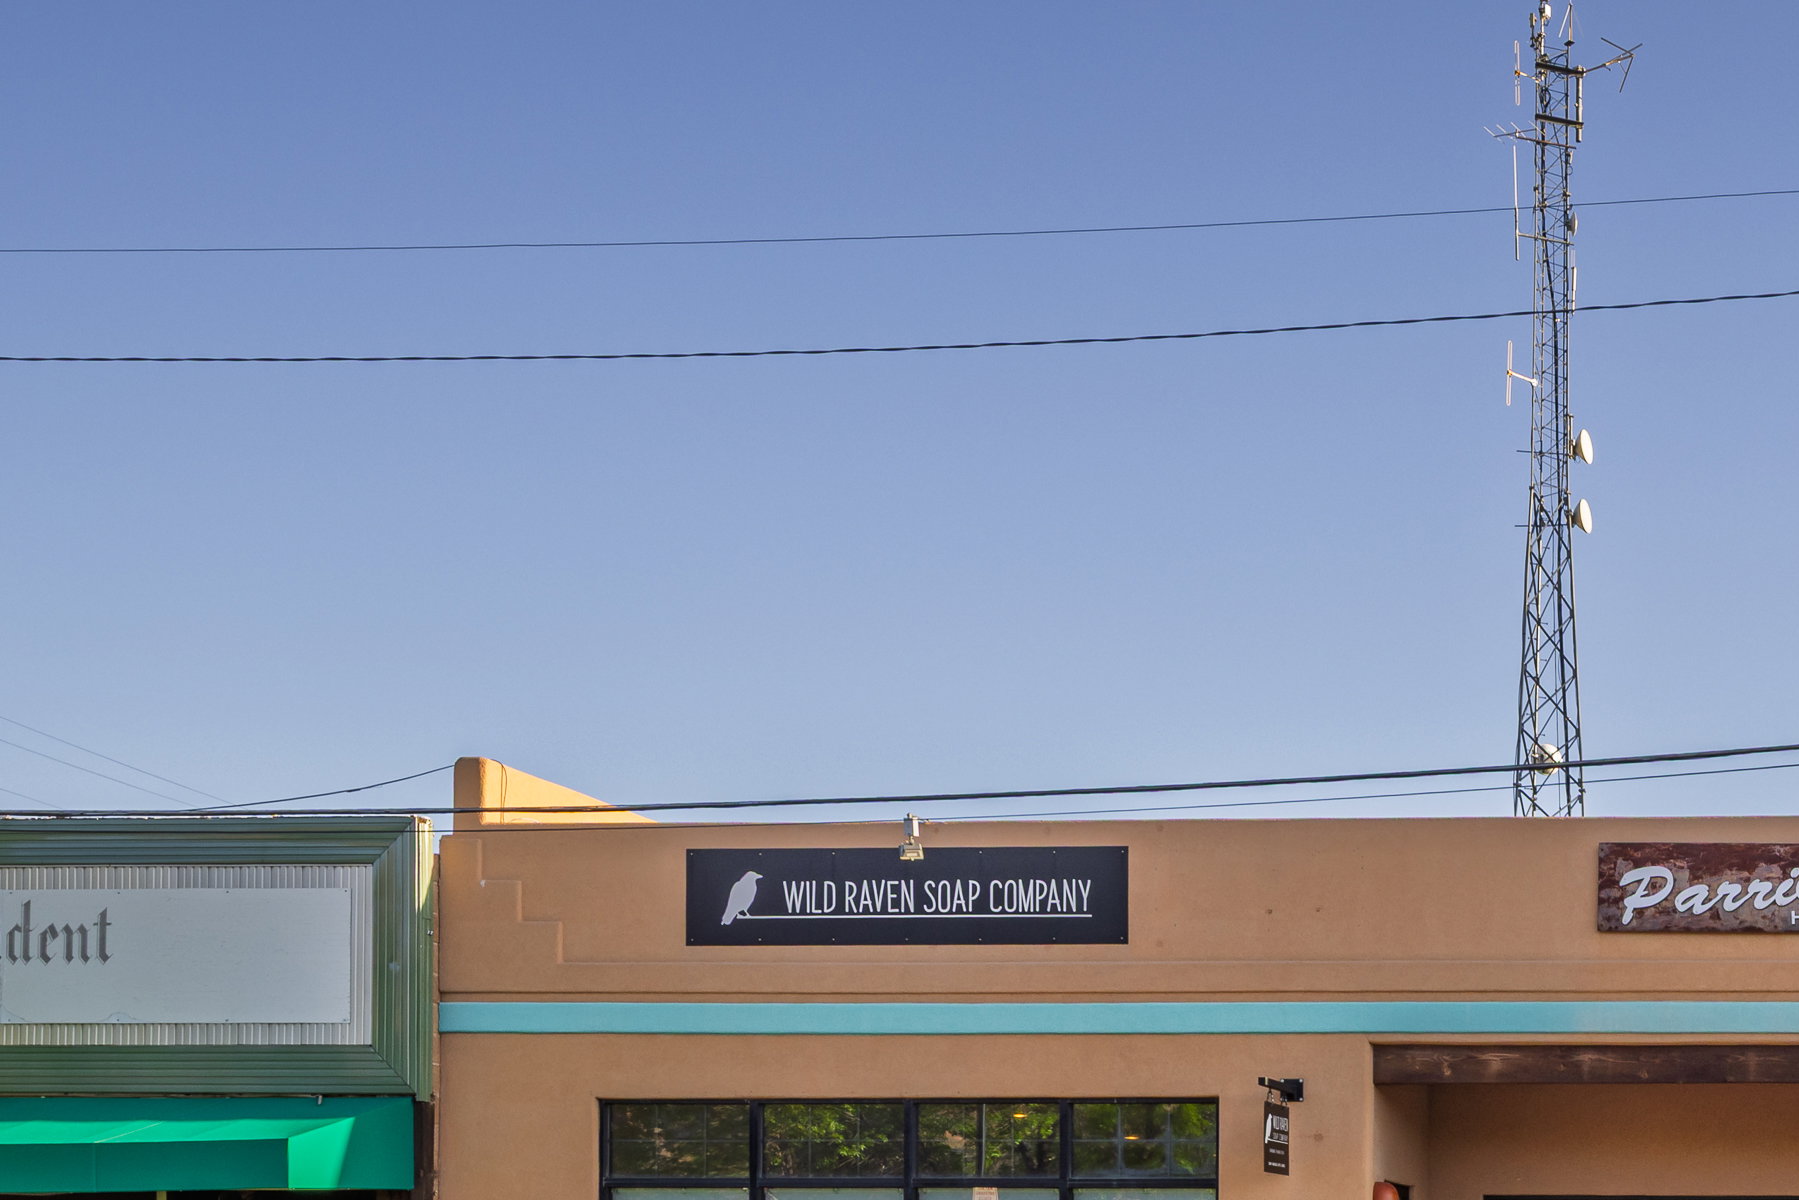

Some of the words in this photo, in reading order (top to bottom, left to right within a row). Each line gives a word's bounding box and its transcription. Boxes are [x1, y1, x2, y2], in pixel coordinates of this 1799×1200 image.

[782, 880, 837, 914] WILD
[844, 880, 915, 914] RAVEN
[923, 878, 981, 913] SOAP
[989, 878, 1091, 912] COMPANY
[0, 899, 113, 967] dent
